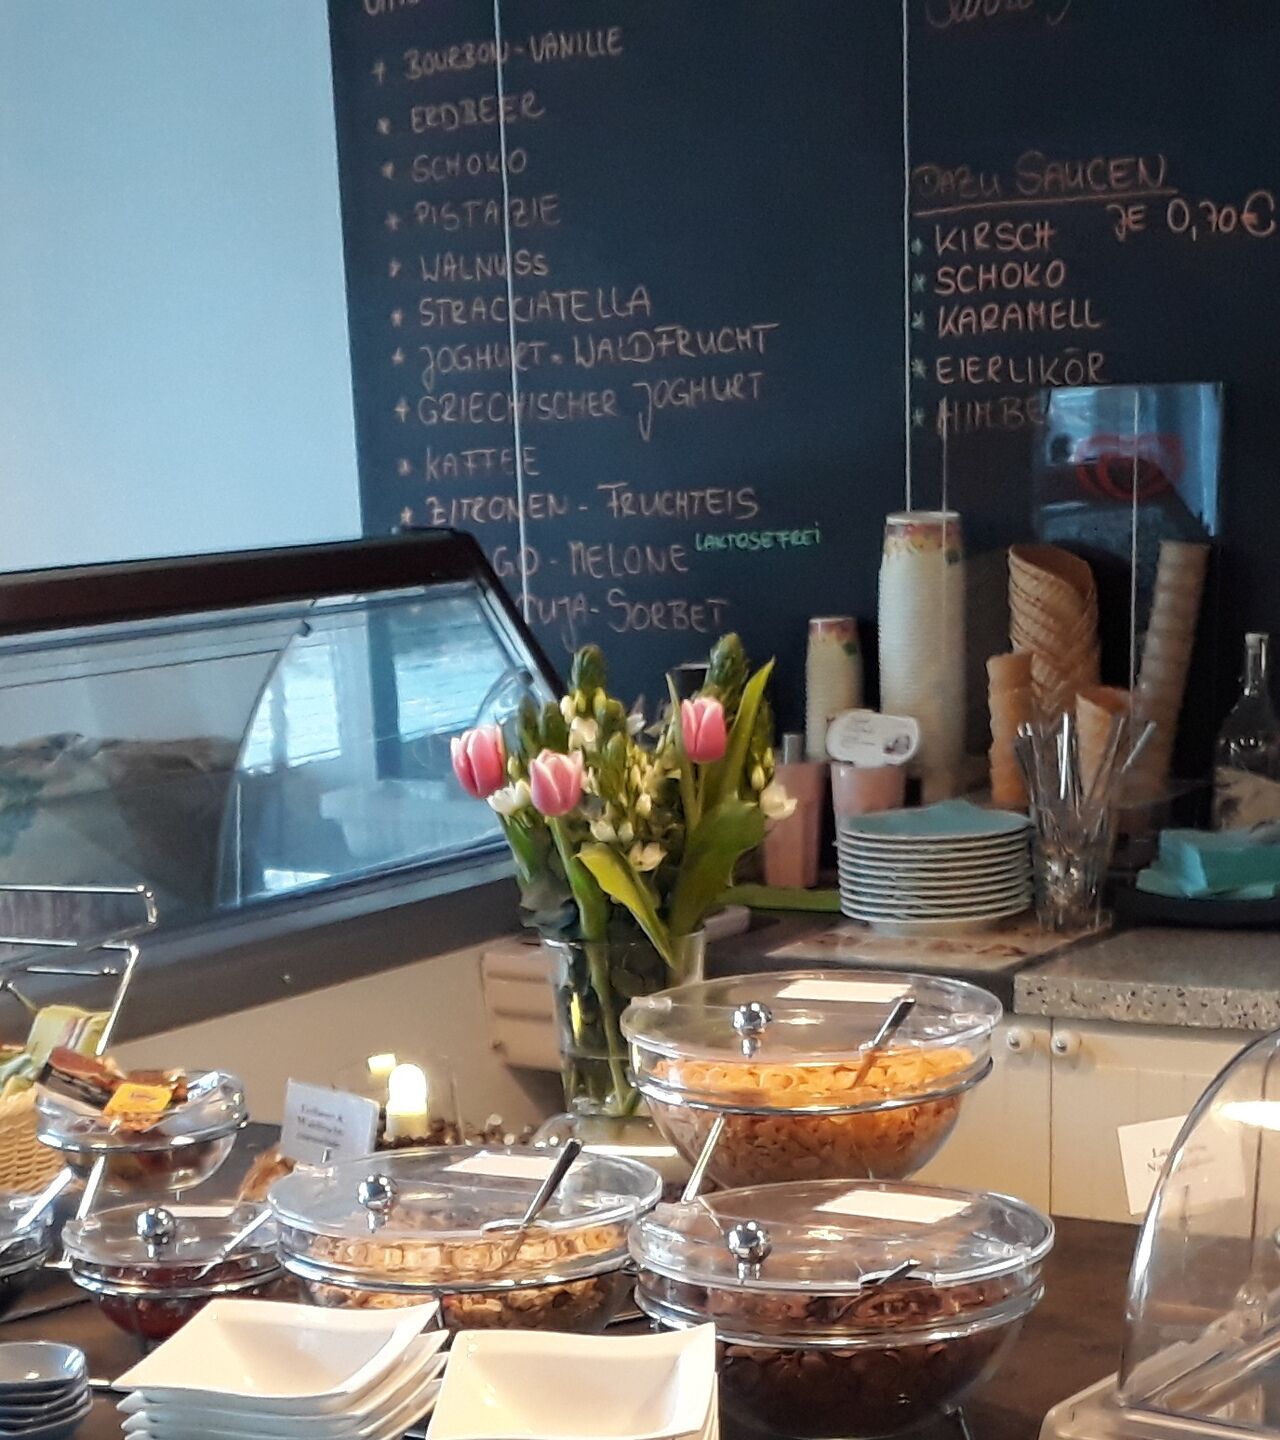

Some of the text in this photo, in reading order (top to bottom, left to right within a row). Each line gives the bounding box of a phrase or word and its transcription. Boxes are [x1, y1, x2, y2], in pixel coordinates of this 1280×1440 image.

[410, 91, 546, 133] ERDBEER
[411, 148, 527, 183] SCHOKO
[1016, 150, 1168, 195] SAUCEN
[414, 193, 562, 231] PISTAZIE
[1106, 202, 1146, 242] JE
[934, 219, 1055, 256] KIRSCH
[420, 250, 549, 283] WALNUSS
[934, 260, 1067, 296] SCHOKO
[420, 285, 652, 327] STRACCIATELLA
[937, 299, 1105, 338] KARAMELL
[935, 346, 1110, 386] EIERLIKÖR
[417, 372, 764, 441] GRIECHISCHER JOGHURT
[937, 396, 1046, 434] HIMBE
[425, 446, 541, 482] KAFFEE
